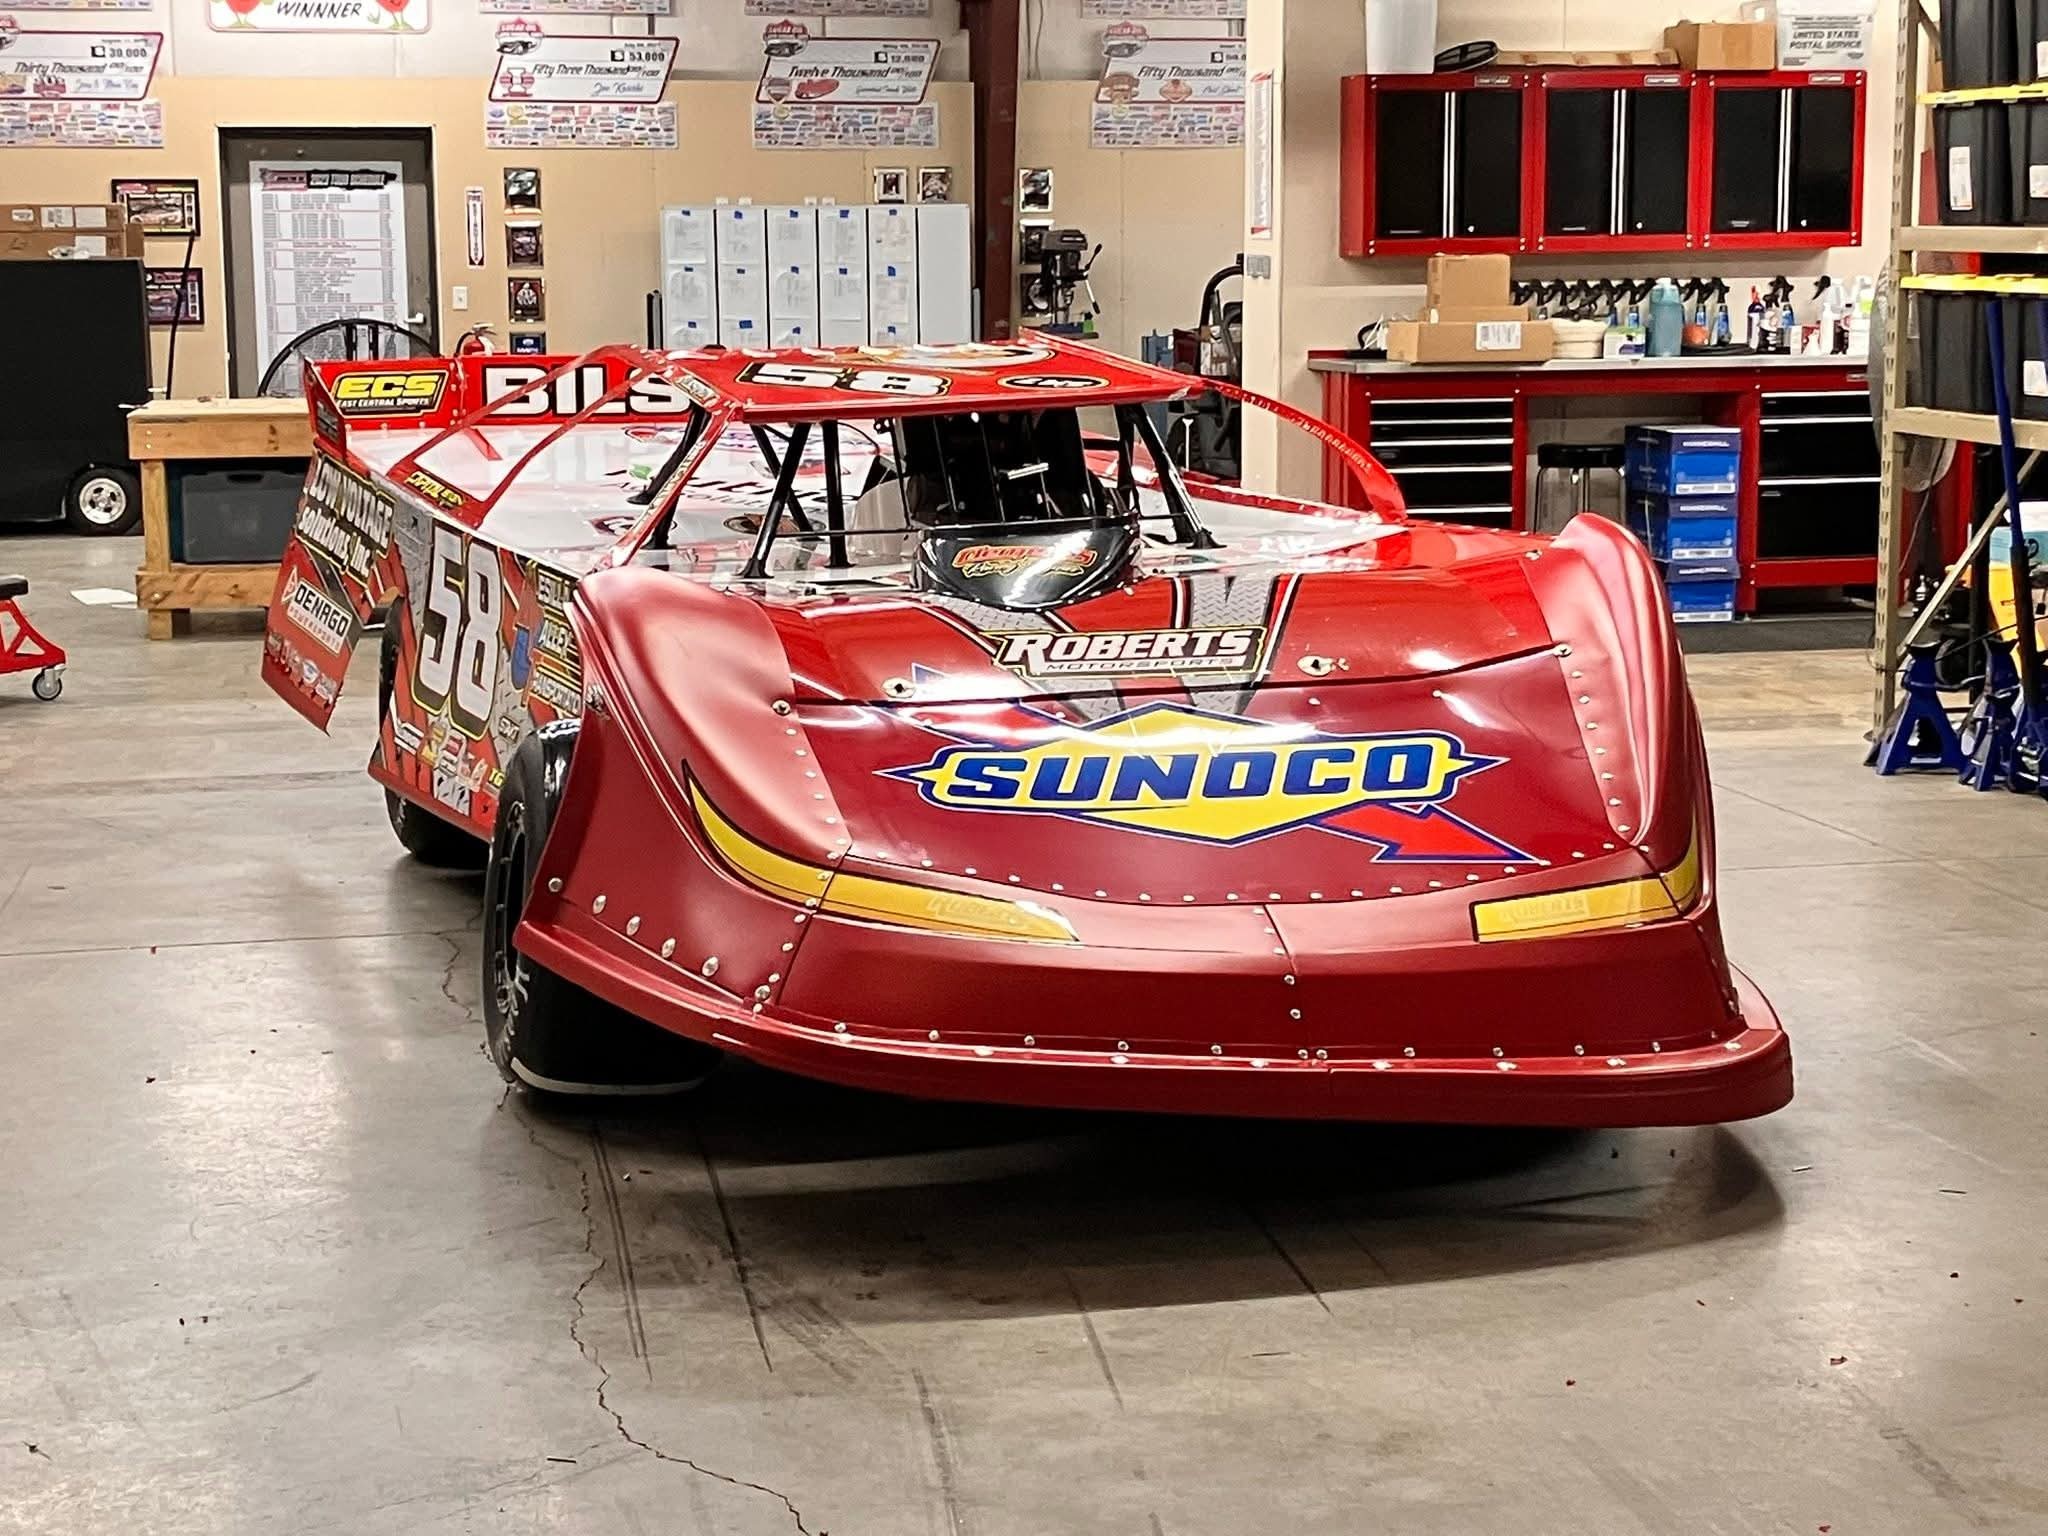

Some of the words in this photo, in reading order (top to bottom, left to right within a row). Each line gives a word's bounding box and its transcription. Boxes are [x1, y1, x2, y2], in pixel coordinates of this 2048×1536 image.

[1793, 31, 1825, 39] UNITED
[1826, 30, 1859, 39] STATES
[1790, 41, 1824, 49] POSTAL
[1825, 40, 1862, 48] SERVICE
[14, 62, 50, 76] Thirty
[50, 62, 107, 74] Thousand
[532, 64, 555, 75] Fifty
[555, 64, 583, 75] Three
[583, 64, 630, 75] Thousand
[788, 66, 829, 78] Twelve
[831, 66, 891, 78] Thousand
[1137, 65, 1167, 80] Fifty
[1168, 65, 1227, 78] Thousand
[336, 374, 440, 399] ECS
[744, 362, 949, 397] 58
[337, 400, 358, 408] EAST
[358, 399, 395, 408] CENTRAL
[396, 398, 430, 407] SPORTS
[341, 475, 393, 549] VOLTAGE
[417, 524, 502, 728] 58
[1003, 629, 1253, 675] ROBERTS
[1046, 657, 1233, 670] MOTORSPORTS
[945, 743, 1434, 802] SUNOCO
